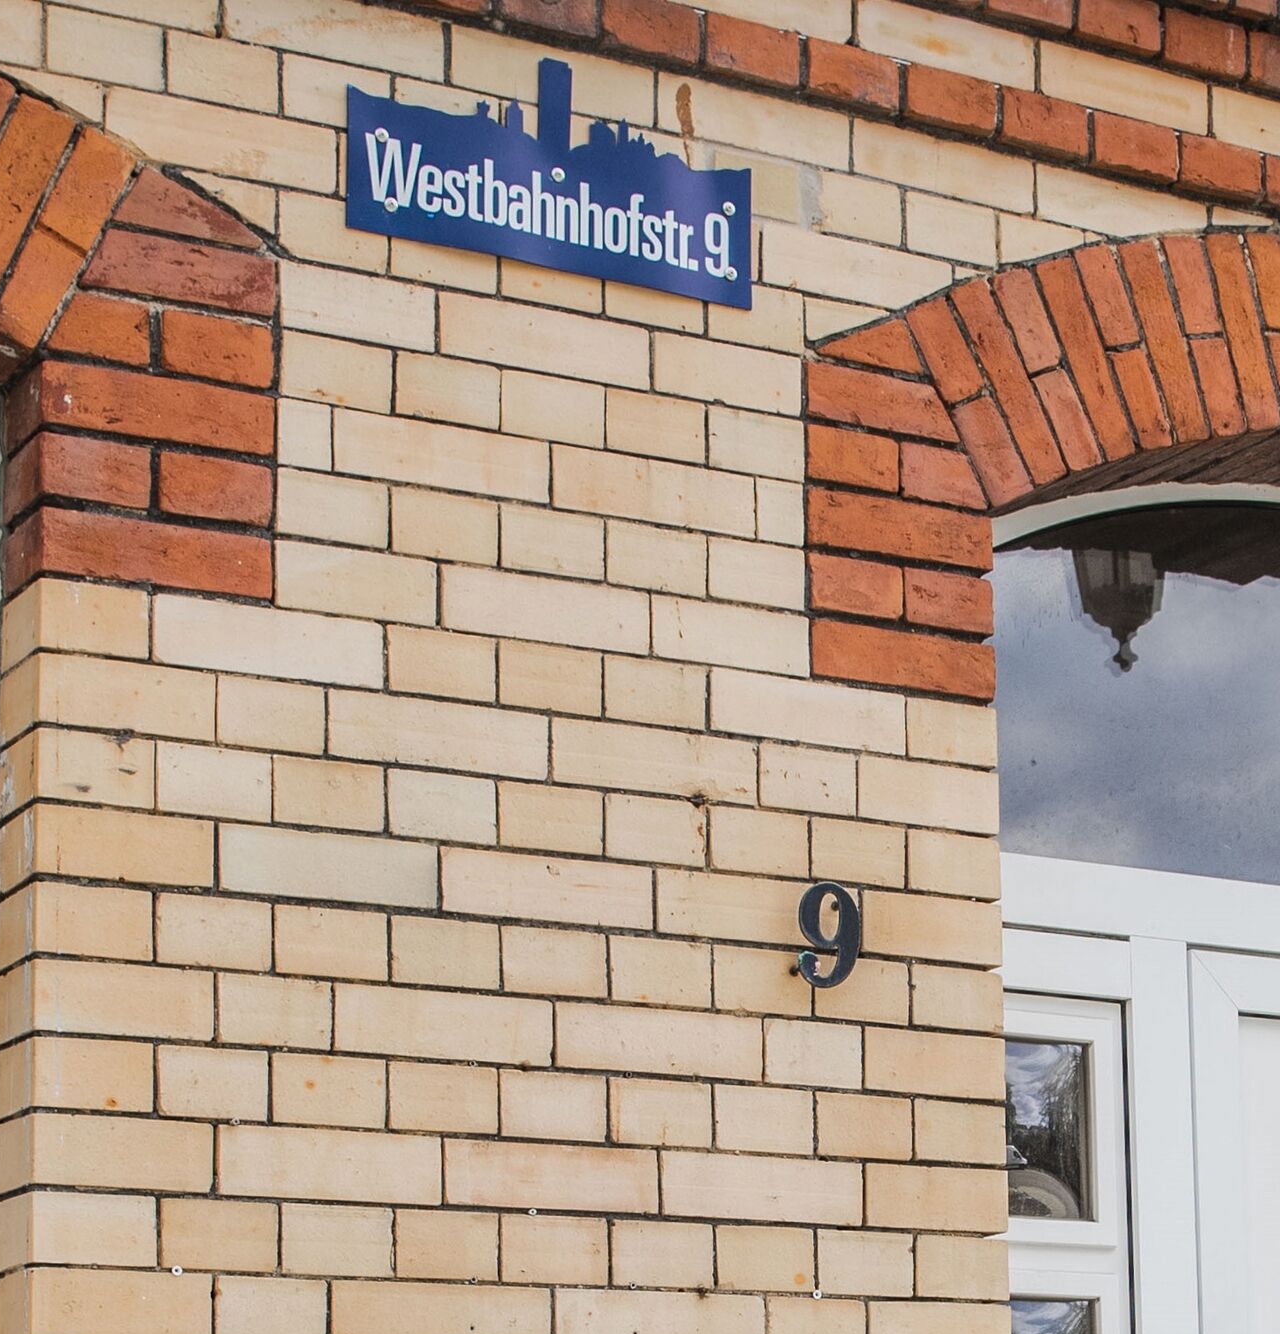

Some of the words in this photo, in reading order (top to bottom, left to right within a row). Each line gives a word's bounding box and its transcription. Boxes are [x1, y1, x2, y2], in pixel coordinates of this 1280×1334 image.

[365, 132, 699, 272] Westbahnhofstr.
[704, 212, 731, 278] 9
[797, 881, 860, 988] 9
